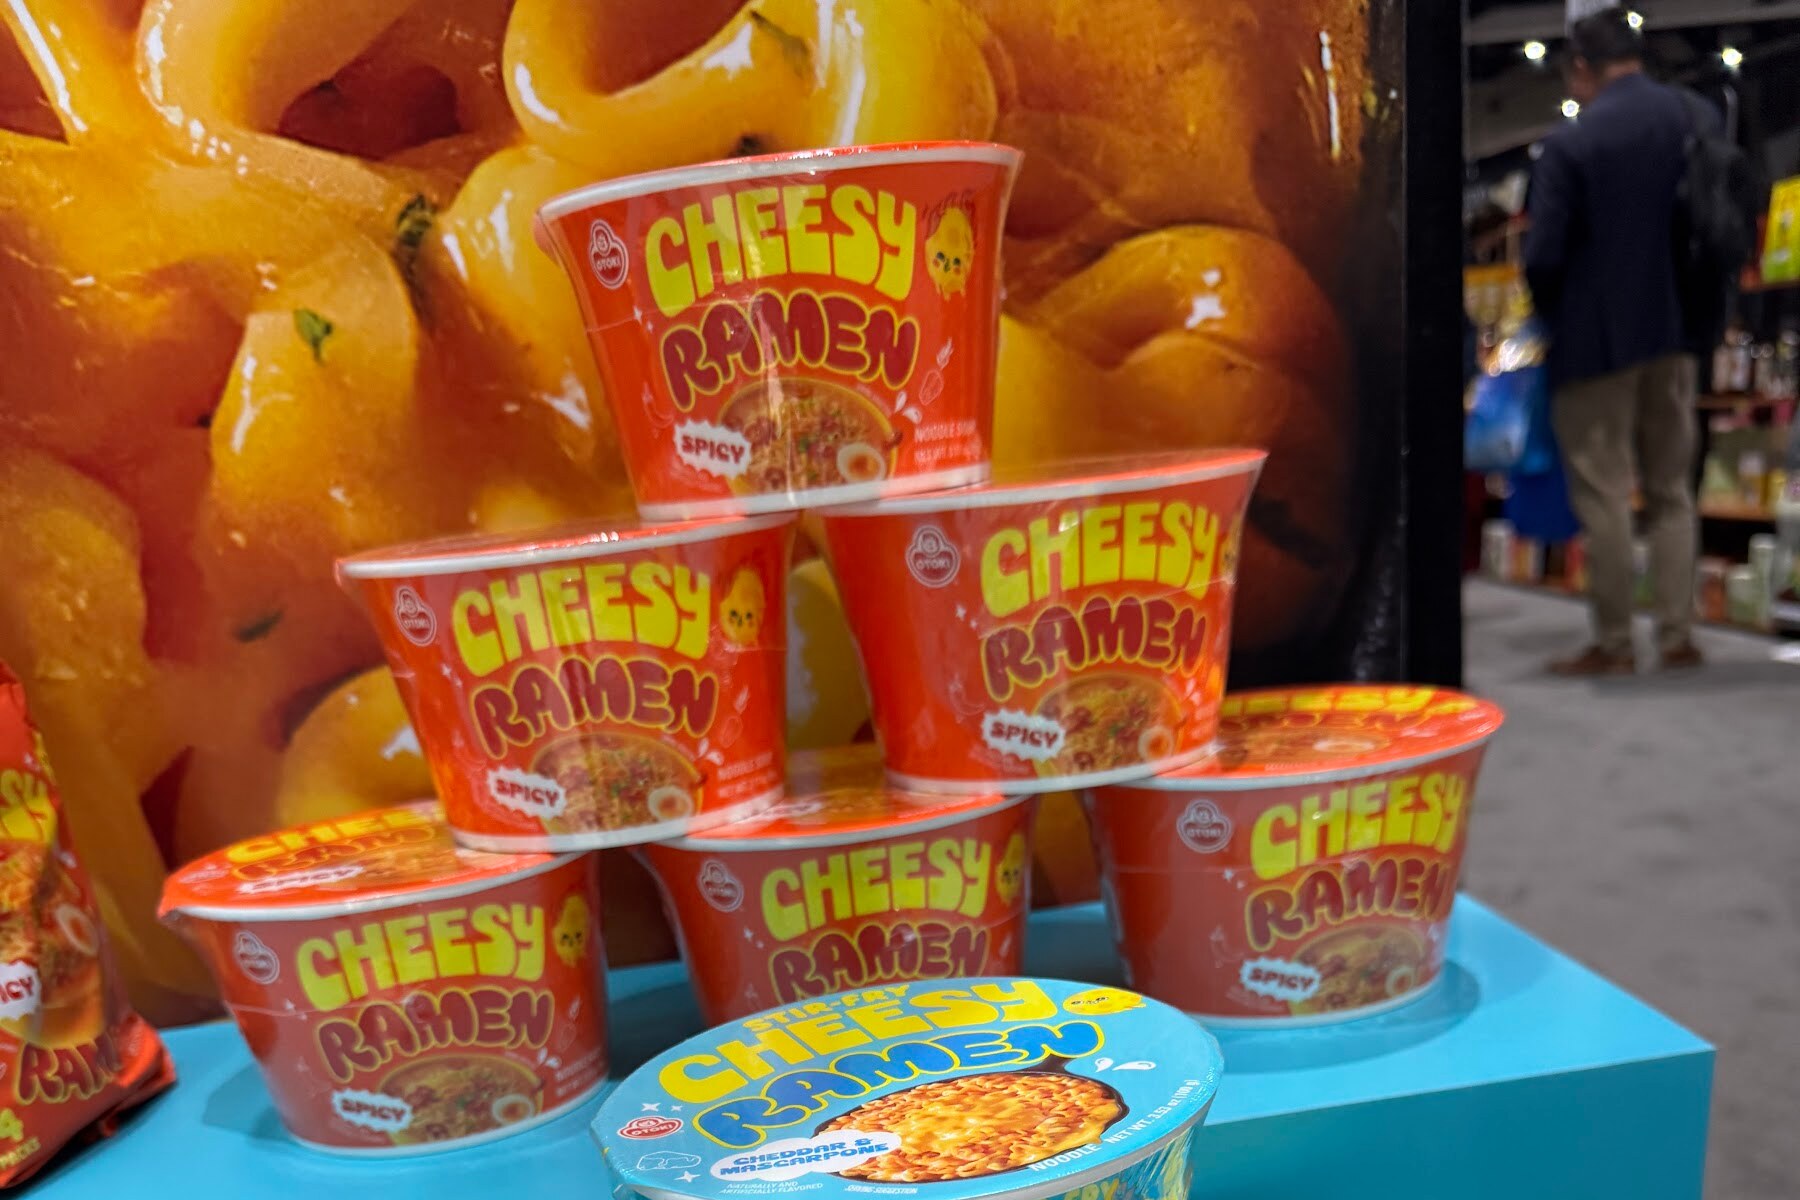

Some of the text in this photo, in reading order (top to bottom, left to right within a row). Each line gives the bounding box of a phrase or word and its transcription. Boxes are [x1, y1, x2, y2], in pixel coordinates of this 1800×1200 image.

[645, 185, 917, 317] CHEESY
[661, 288, 921, 412] RAMEN
[682, 434, 746, 465] SPICY
[980, 501, 1219, 618] CHEESY
[452, 562, 711, 677] CHEESY
[981, 595, 1207, 702] RAMEN
[471, 653, 719, 760] RAMEN
[990, 721, 1060, 748] SPICY
[494, 779, 560, 809] SPICY
[1250, 772, 1465, 880] CHEESY
[760, 838, 992, 942] CHEESY
[1245, 855, 1452, 952] RAMEN
[296, 904, 546, 1012] CHEESY
[768, 921, 991, 1005] RAMEN
[1249, 967, 1315, 991] SPICY
[315, 984, 556, 1085] RAMEN
[659, 980, 1061, 1105] CHEESY
[742, 984, 912, 1033] STIR-FRY
[339, 1099, 406, 1122] SPICY
[631, 1123, 675, 1137] OTOKI
[692, 1020, 1106, 1150] RAMEN
[719, 1142, 890, 1176] MASCARPONE
[733, 1137, 874, 1166] CHEDDAR &
[1028, 1143, 1102, 1172] NOODLE
[1104, 1130, 1129, 1144] NET
